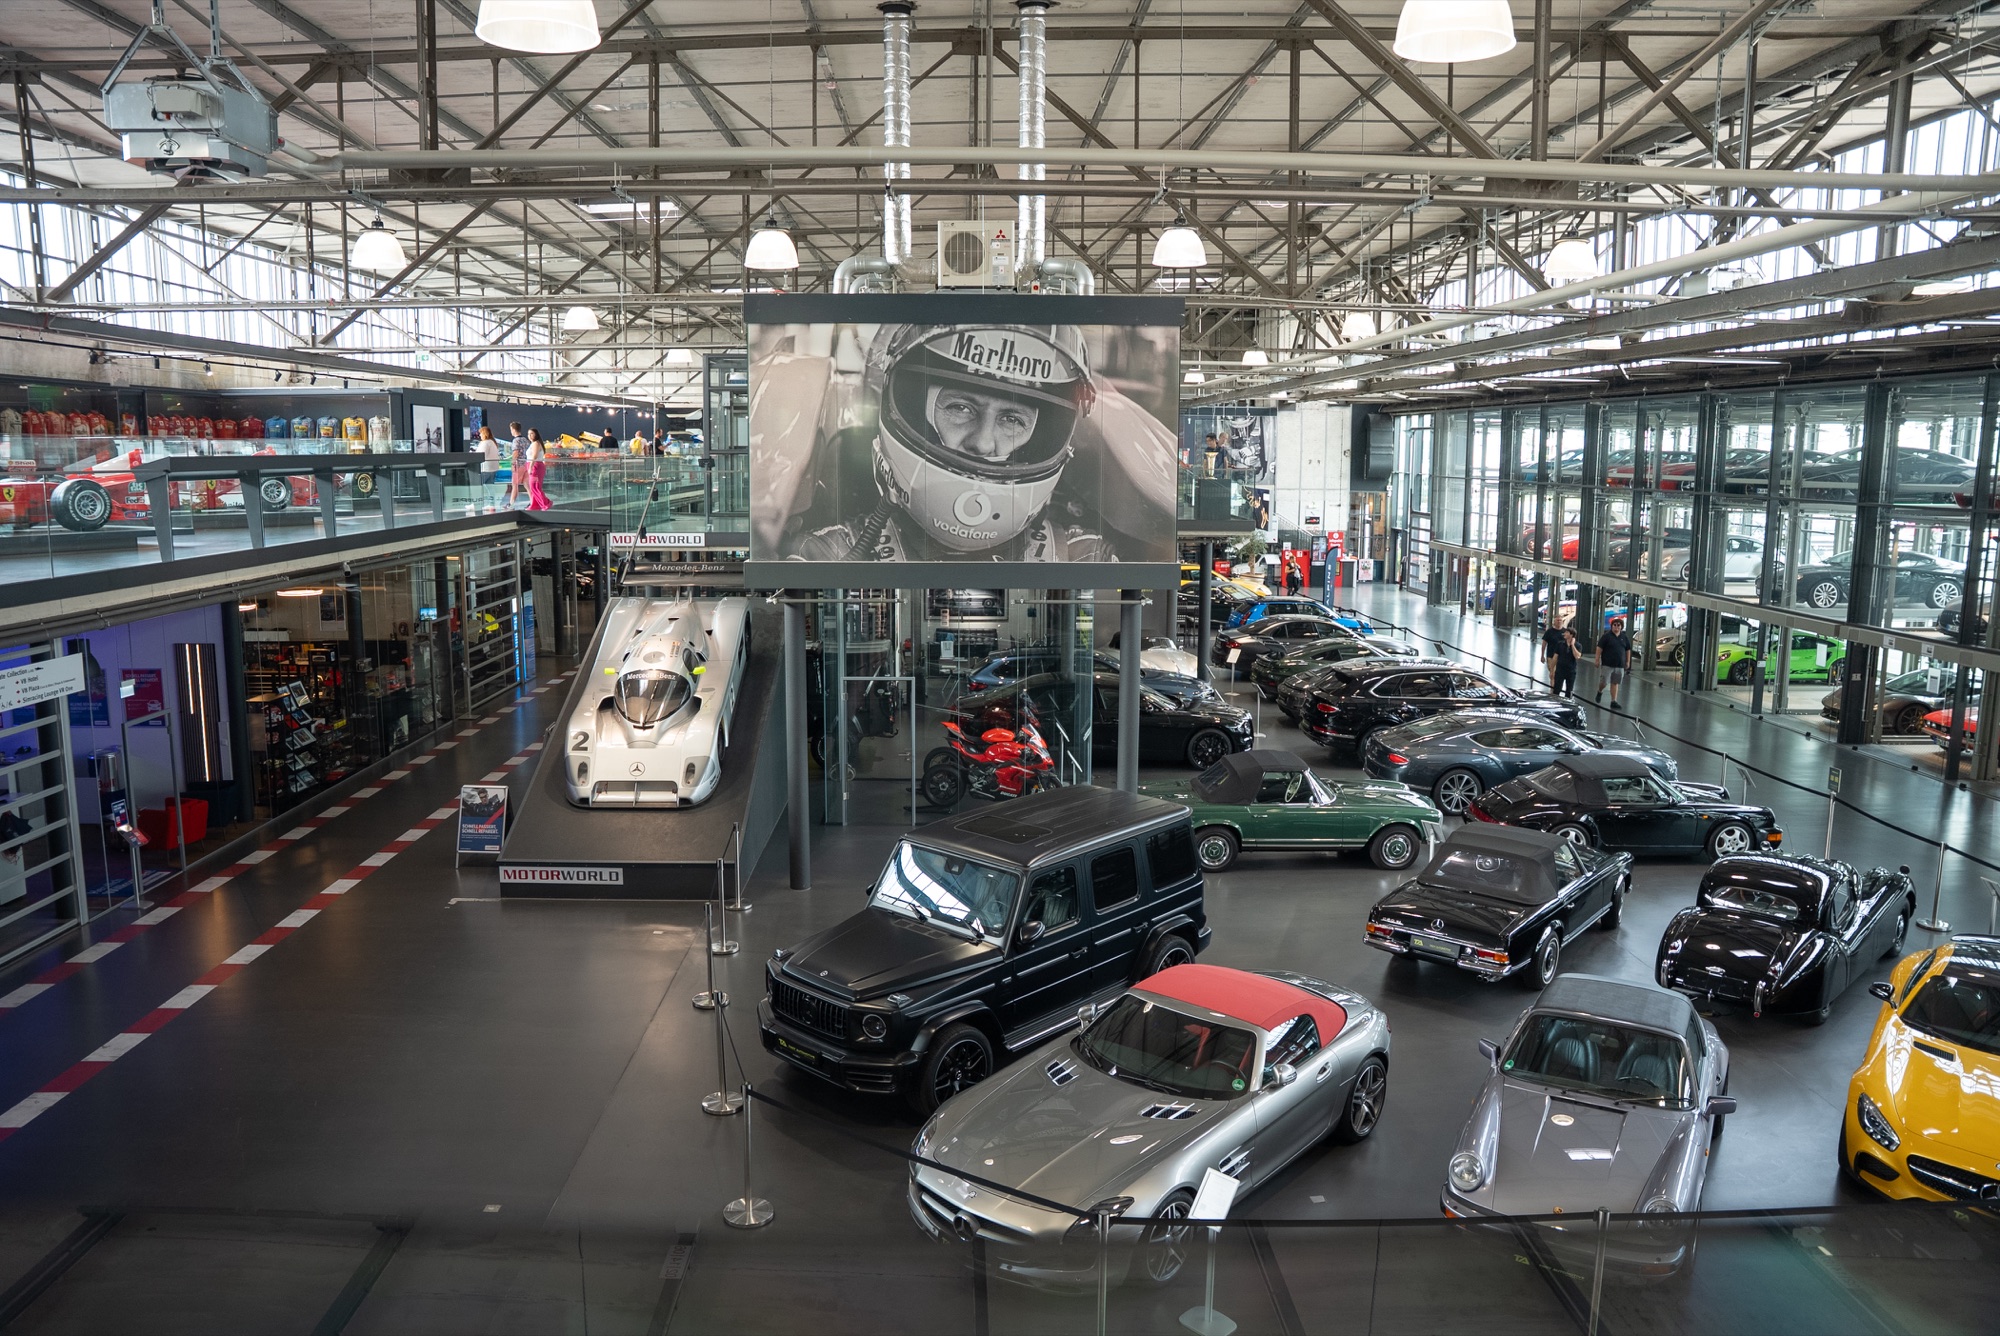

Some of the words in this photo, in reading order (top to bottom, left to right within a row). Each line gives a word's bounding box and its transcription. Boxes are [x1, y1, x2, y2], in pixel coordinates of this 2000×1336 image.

[952, 332, 1051, 379] Marlboro
[933, 518, 998, 540] vodafone
[7, 669, 28, 678] Collection
[627, 672, 676, 680] Merced-Benz
[22, 693, 44, 703] Simracing
[44, 689, 59, 697] Lounge
[571, 731, 590, 751] 2
[503, 869, 619, 882] MOTORWORLD
[1513, 1254, 1530, 1265] TA
